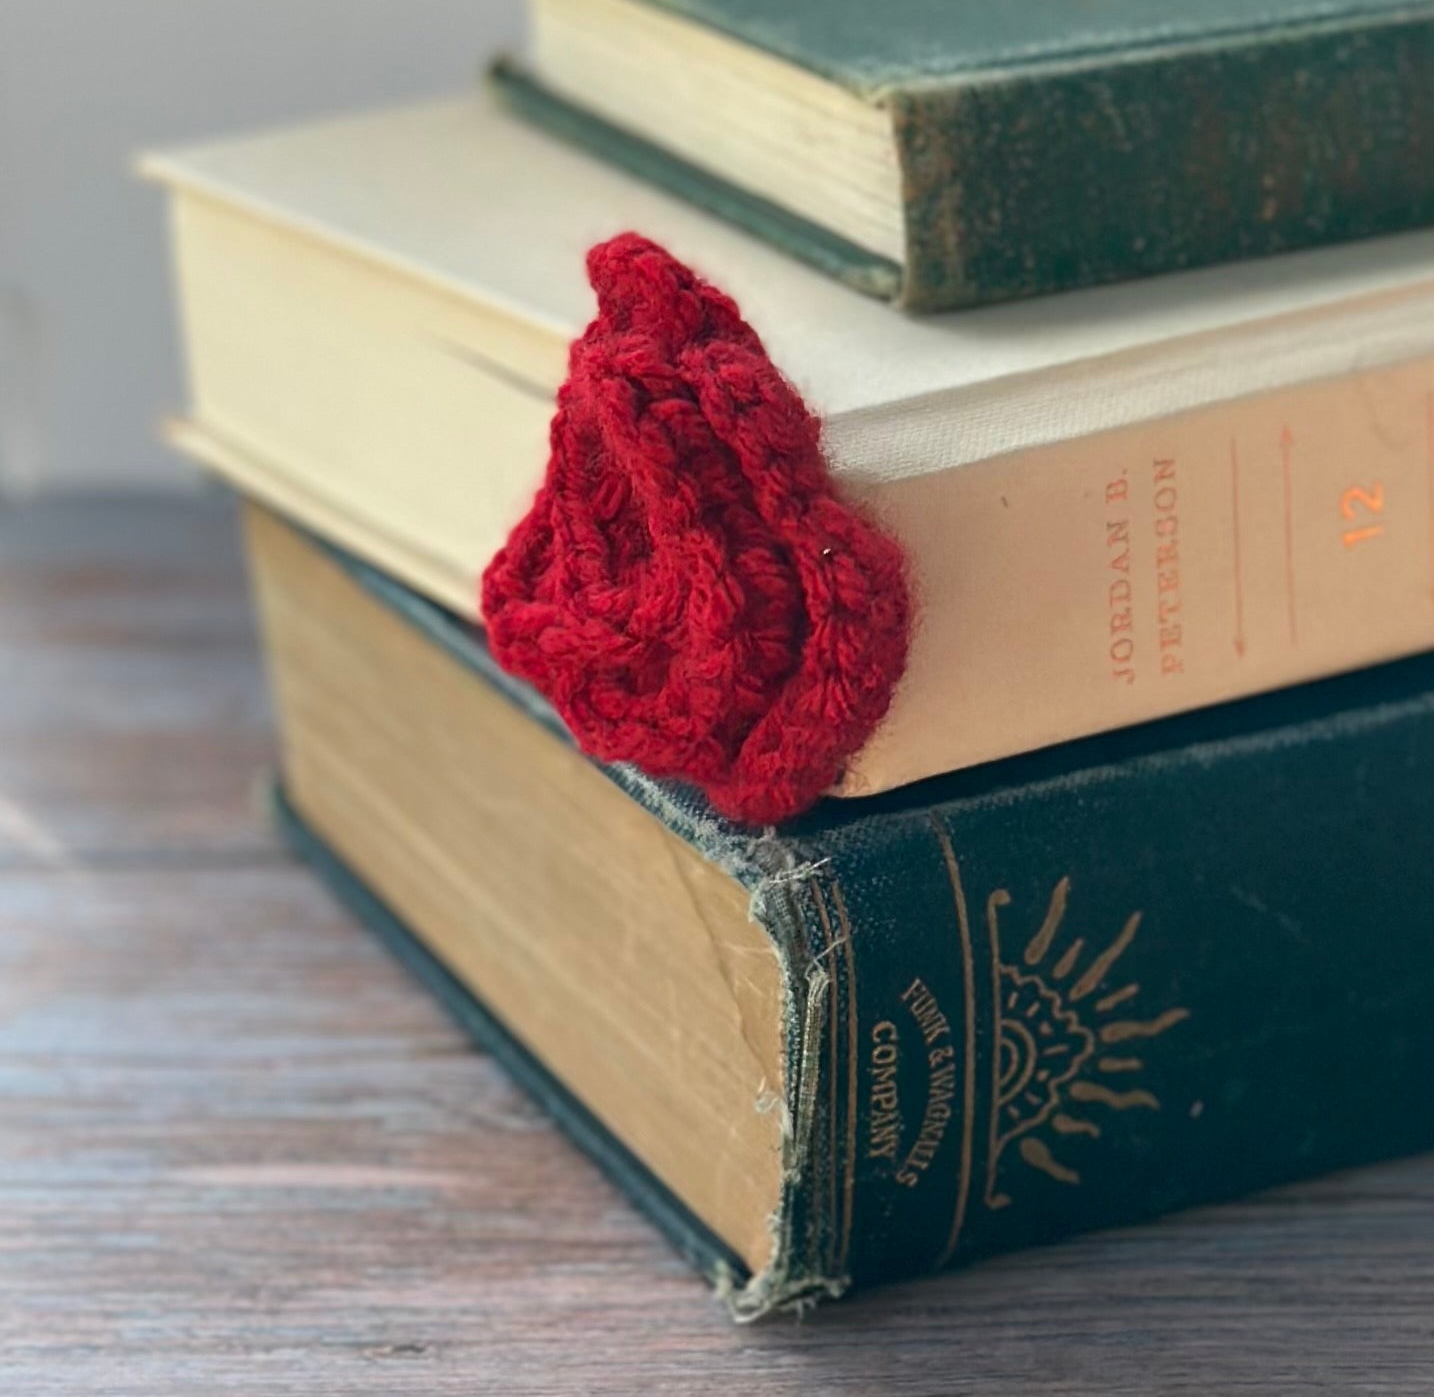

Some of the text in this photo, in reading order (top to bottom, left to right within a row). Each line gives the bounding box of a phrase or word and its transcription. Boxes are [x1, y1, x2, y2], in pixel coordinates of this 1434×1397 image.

[1105, 468, 1135, 685] JORDAN B.
[1153, 458, 1184, 676] PETERSON
[1339, 482, 1384, 548] 12
[869, 1021, 898, 1158] COMPANY
[897, 977, 955, 1186] FUNK & WAGNALLS
